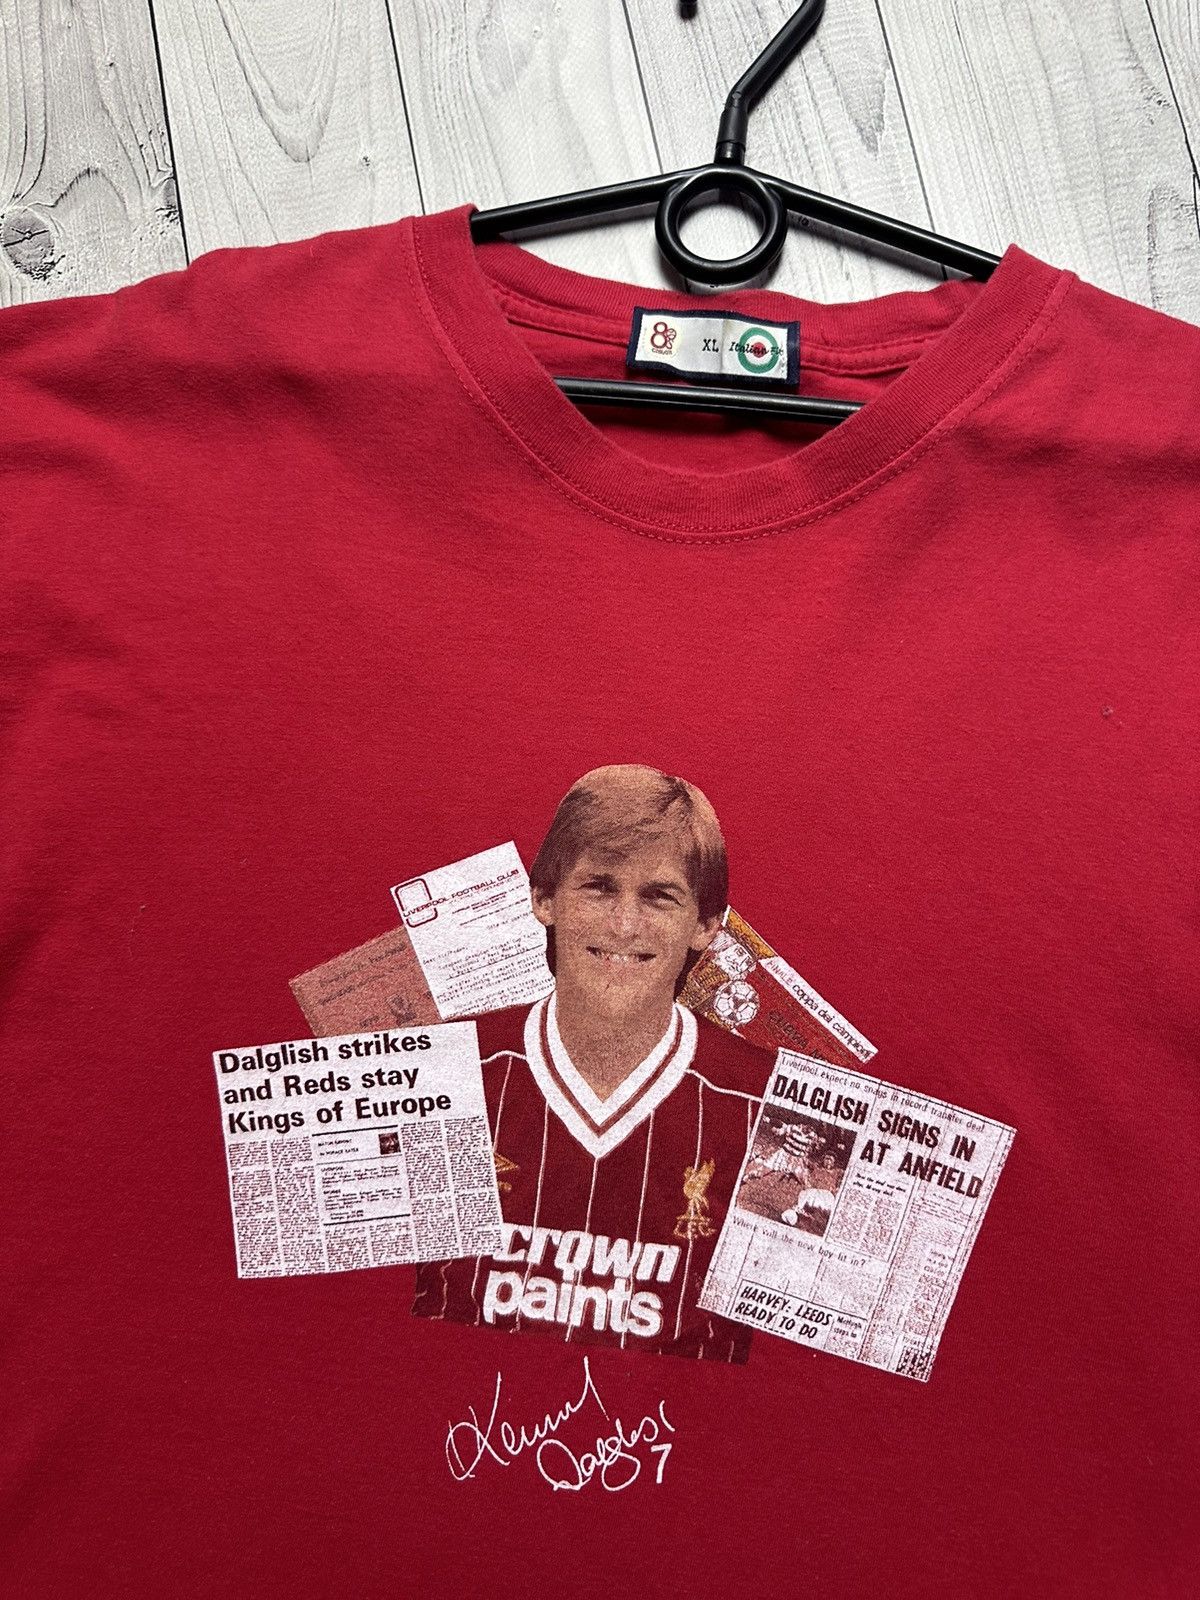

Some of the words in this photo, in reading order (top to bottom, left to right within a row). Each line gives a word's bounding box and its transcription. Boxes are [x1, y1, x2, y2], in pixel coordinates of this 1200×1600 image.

[702, 338, 720, 353] XL
[728, 341, 769, 355] Italian
[402, 896, 450, 918] LIVERPOOL
[451, 878, 496, 899] FOOTBALL
[496, 868, 520, 883] CLUB
[792, 983, 819, 1012] coppa
[817, 1006, 836, 1024] dei
[218, 1041, 329, 1074] Dalglish
[338, 1033, 432, 1060] strikes
[223, 1078, 273, 1105] and
[283, 1070, 351, 1097] Reds
[361, 1066, 420, 1090] stay
[781, 1056, 819, 1076] Liverpool
[820, 1070, 848, 1085] expect
[890, 1091, 899, 1102] in
[900, 1097, 929, 1112] record
[227, 1108, 306, 1134] Kings
[316, 1099, 344, 1125] of
[354, 1093, 452, 1120] Europe
[772, 1073, 869, 1126] DALGLISH
[876, 1108, 941, 1150] SIGNS
[949, 1133, 977, 1163] IN
[859, 1139, 890, 1167] AT
[897, 1152, 984, 1200] ANFIELD
[492, 1222, 682, 1283] crown
[482, 1270, 664, 1338] paints
[734, 1301, 777, 1324] READY
[778, 1315, 796, 1331] TO
[799, 1323, 818, 1339] DO
[740, 1285, 792, 1313] HARVEY:
[794, 1304, 833, 1326] LEEDS
[650, 1443, 672, 1484] 7
